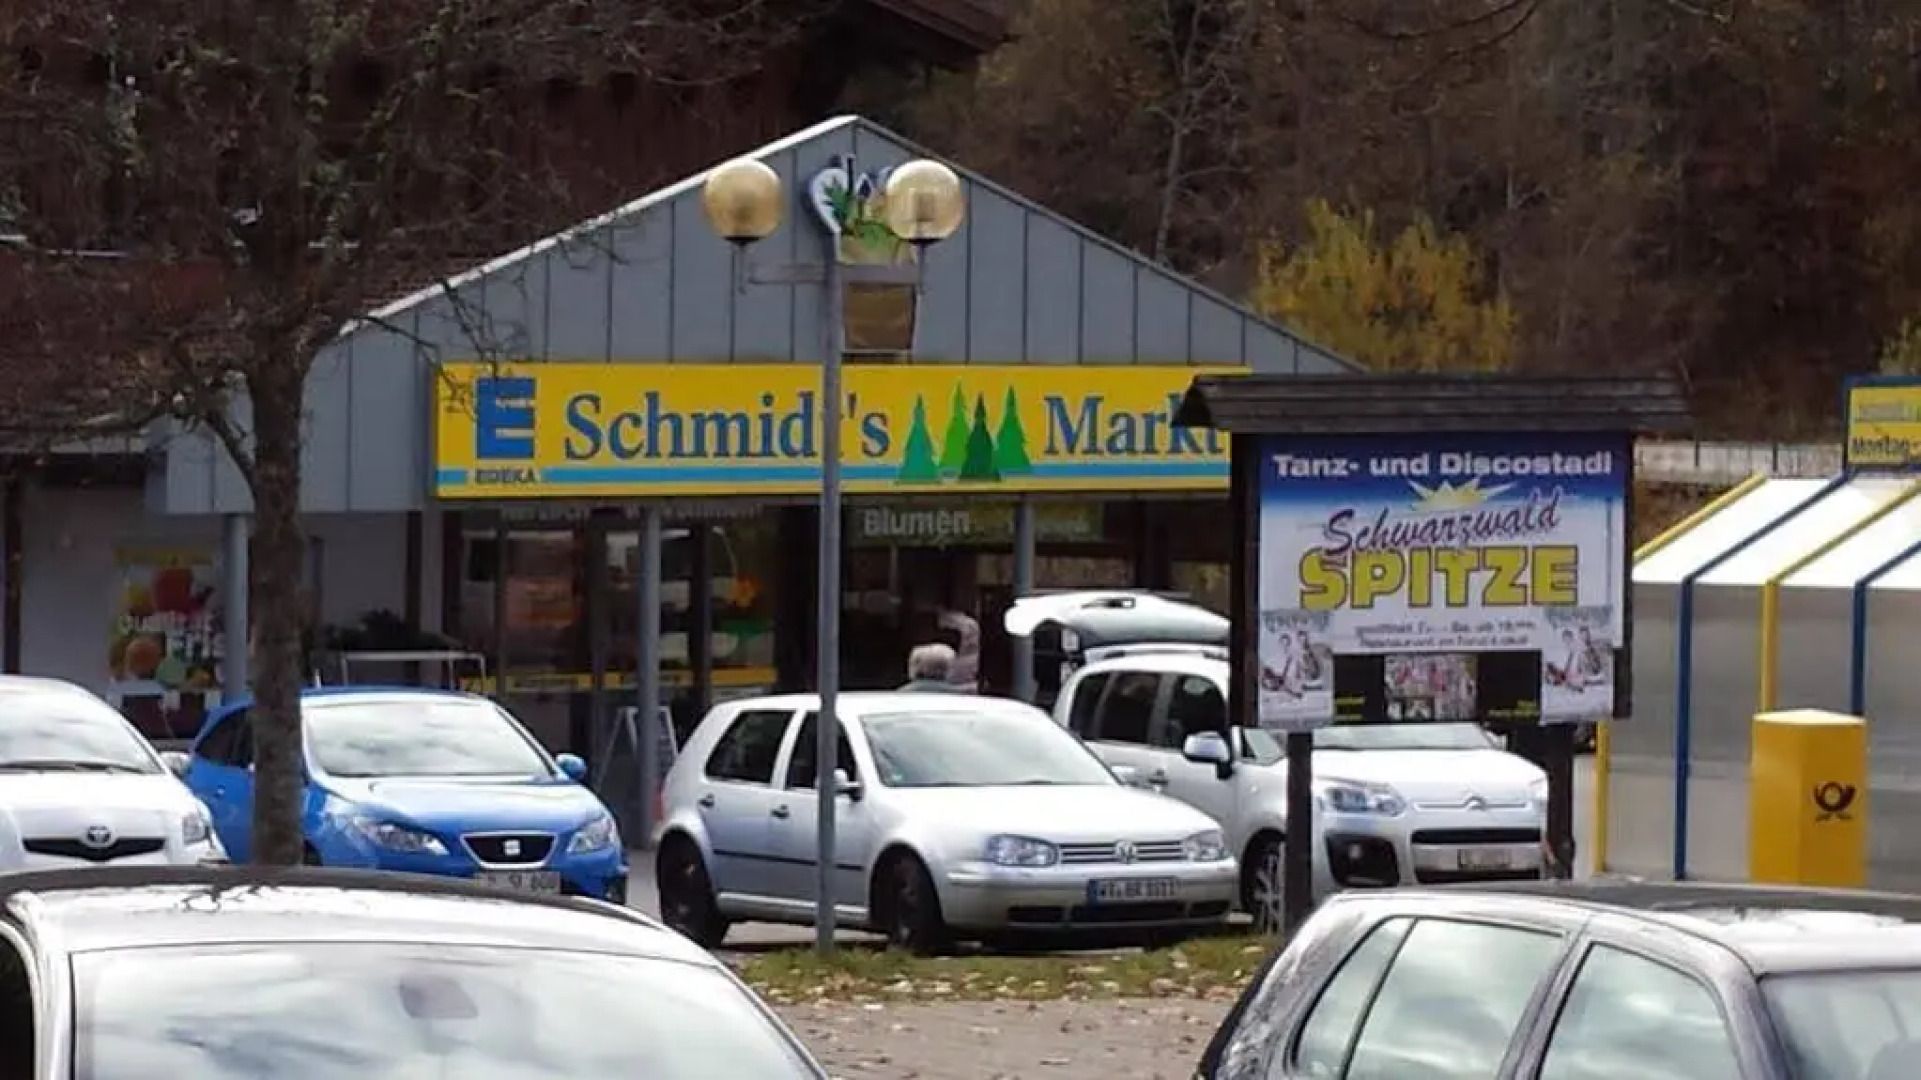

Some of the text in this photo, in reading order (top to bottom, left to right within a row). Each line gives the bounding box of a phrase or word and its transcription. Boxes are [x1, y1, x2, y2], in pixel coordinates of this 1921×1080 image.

[564, 390, 891, 461] Schmid's
[1273, 451, 1612, 477] Tanz- und Discostadl
[863, 507, 971, 536] Blumen
[1325, 484, 1562, 554] Schwarzwald
[1299, 543, 1579, 610] SPITZE
